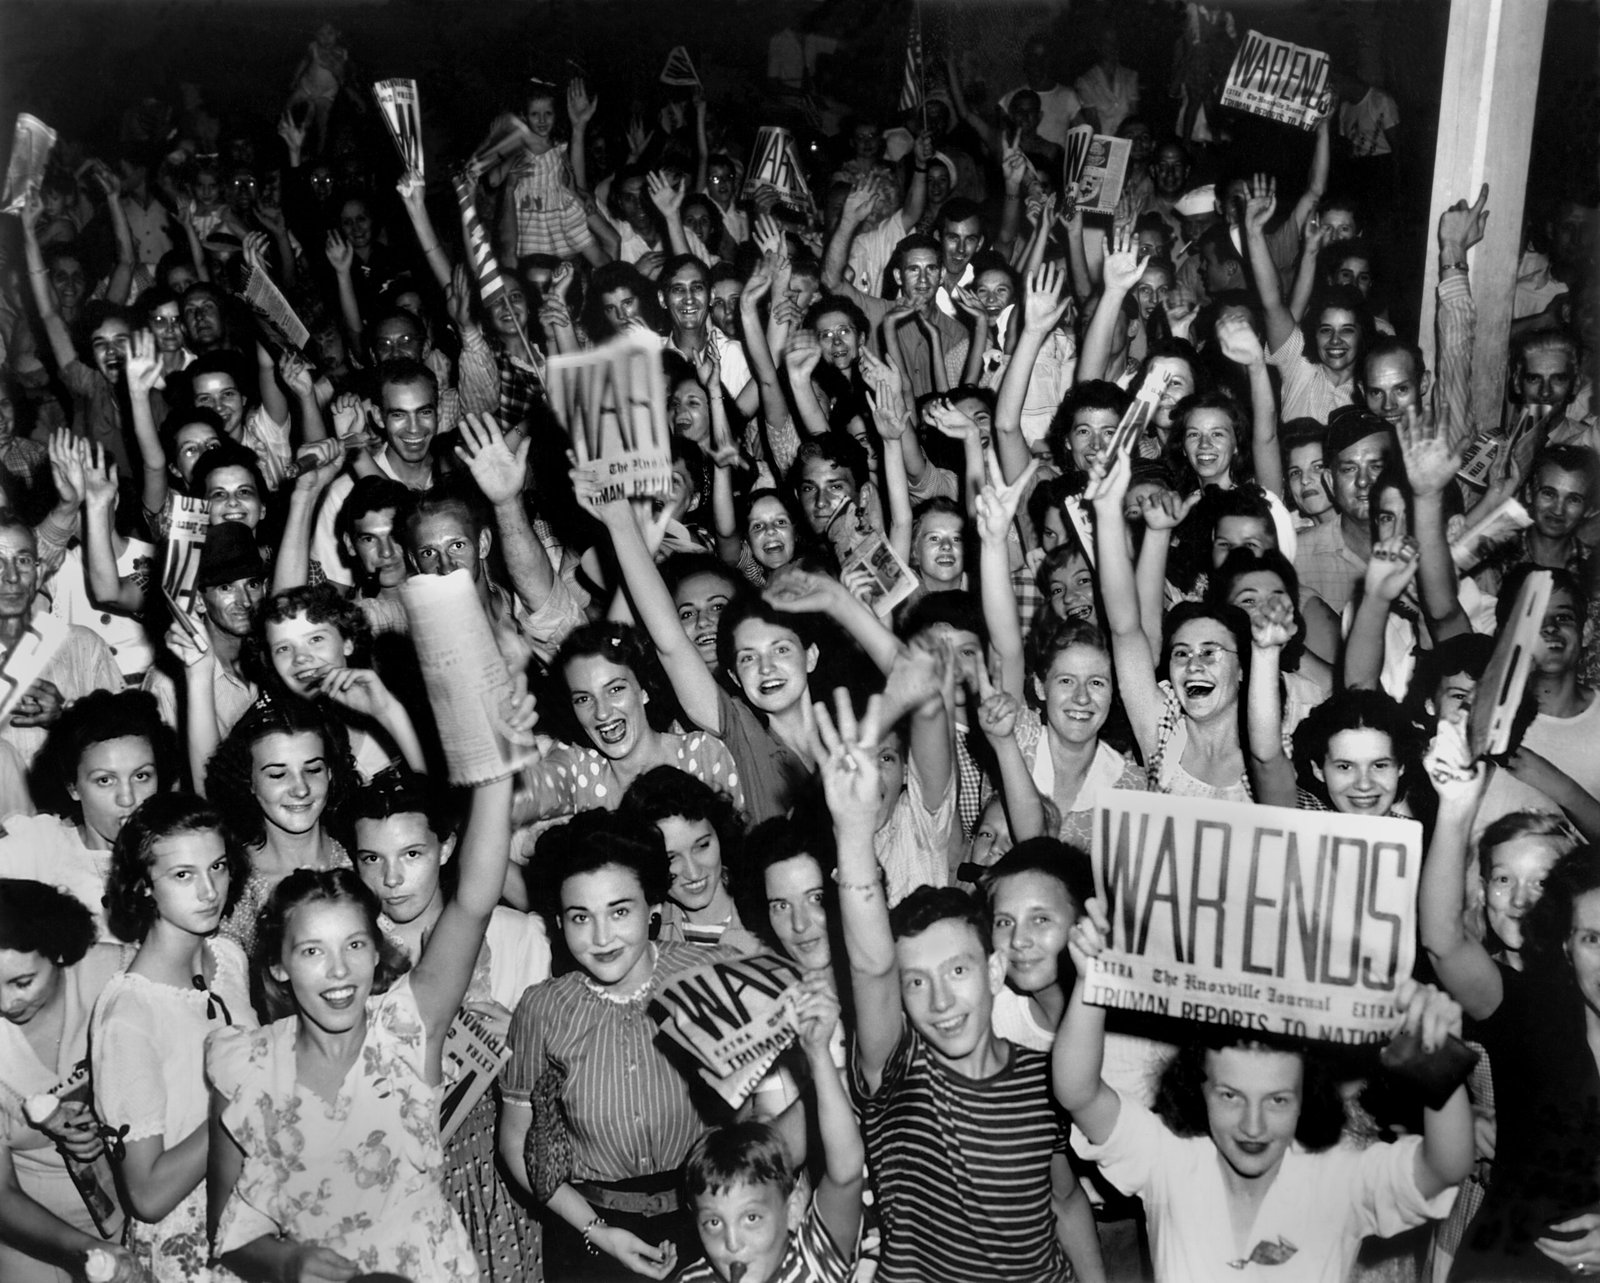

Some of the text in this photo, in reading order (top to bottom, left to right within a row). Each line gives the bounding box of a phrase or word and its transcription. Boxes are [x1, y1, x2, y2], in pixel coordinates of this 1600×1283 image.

[1233, 34, 1290, 96] WAR
[562, 346, 659, 462] WAR
[608, 460, 629, 475] The
[1102, 808, 1407, 992] WAR ENDS
[663, 954, 803, 1041] WAR
[1092, 985, 1169, 1016] TRUMAN
[1181, 1002, 1269, 1032] REPORTS
[1281, 1018, 1306, 1037] TO
[1094, 960, 1395, 1020] EXTRA The Knoxville Journal EXTRA
[458, 1006, 506, 1059] TRUMAN
[466, 1042, 495, 1073] EXTRA
[727, 1022, 796, 1071] TRUMAN
